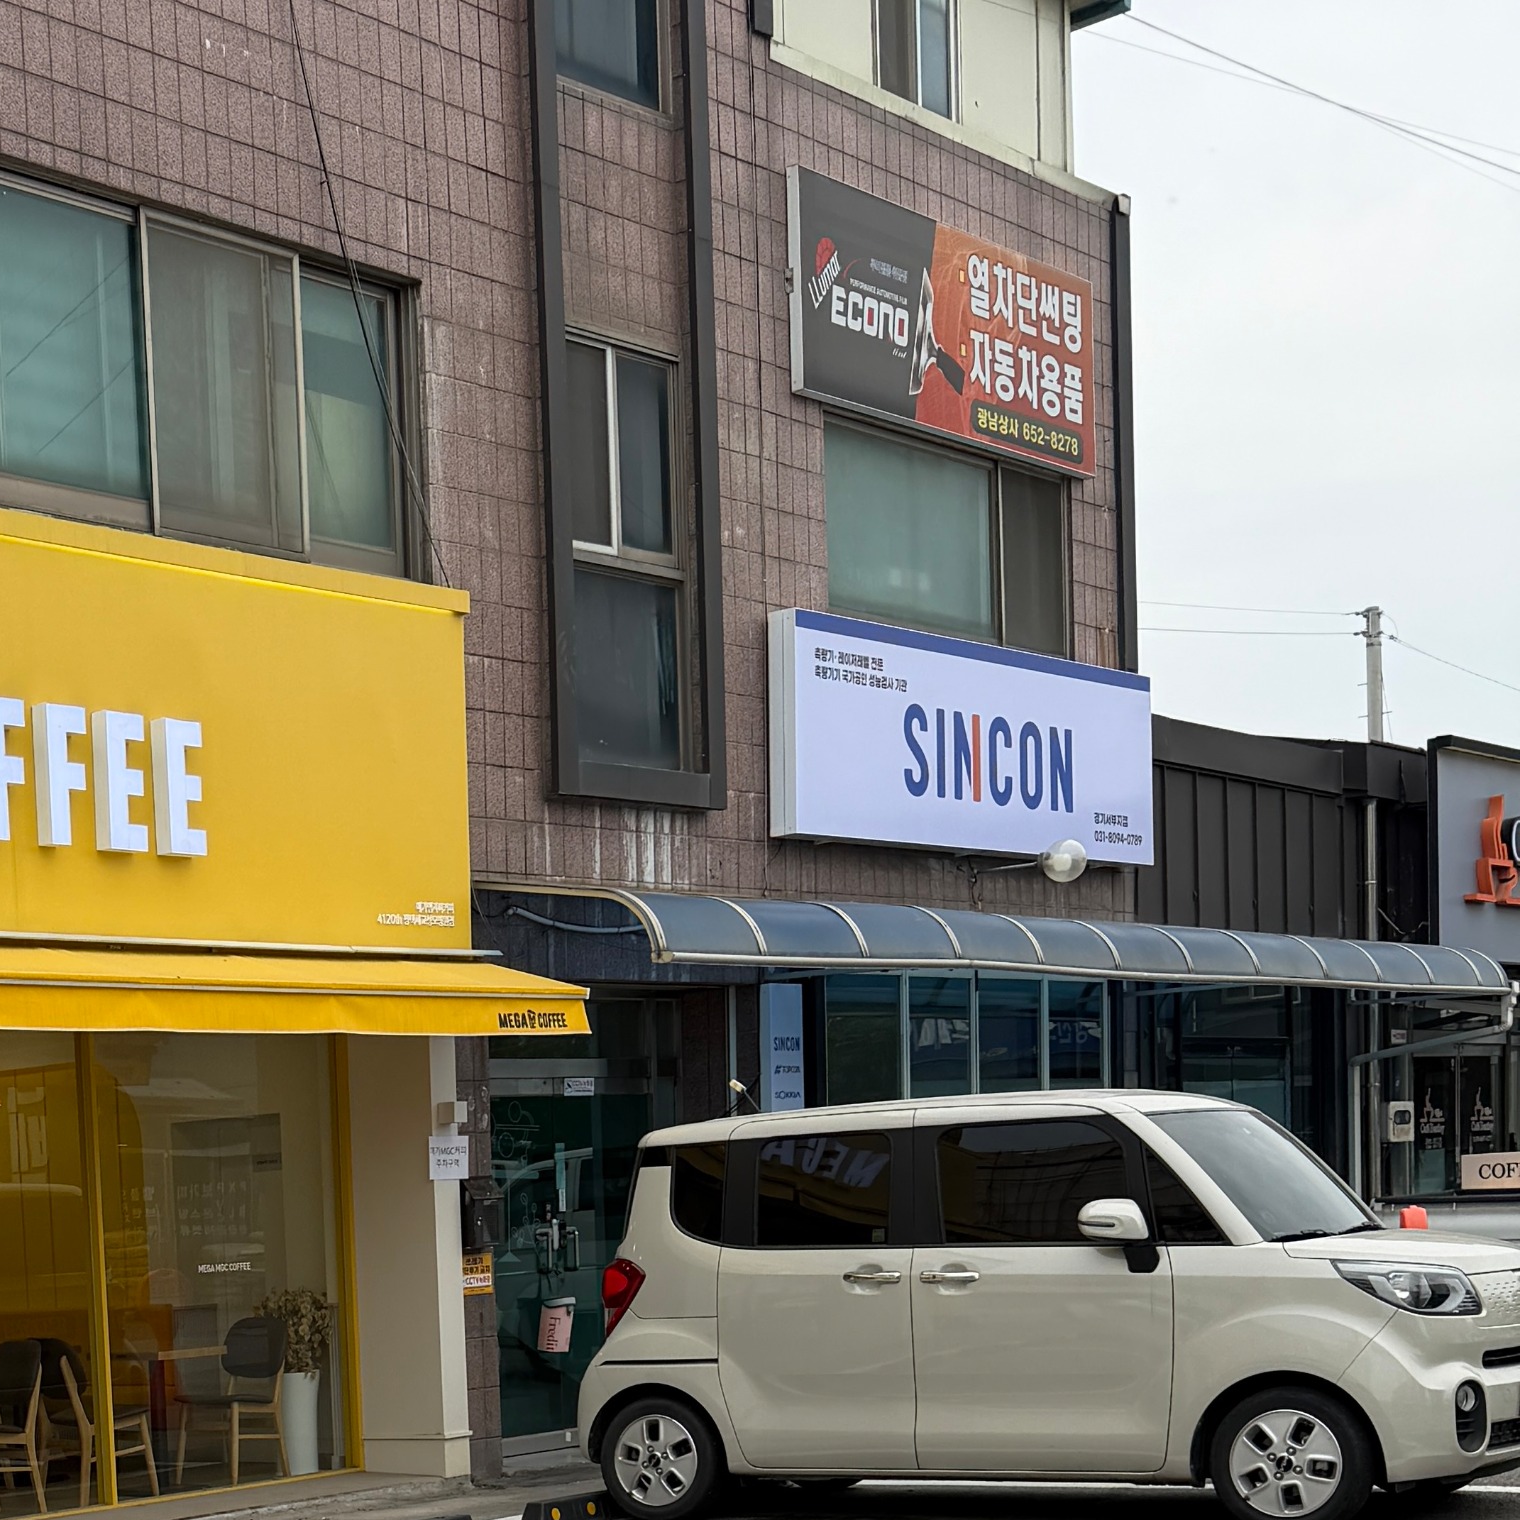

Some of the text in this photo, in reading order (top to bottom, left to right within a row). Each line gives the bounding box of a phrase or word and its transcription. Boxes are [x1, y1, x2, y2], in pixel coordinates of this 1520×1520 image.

[967, 254, 1083, 354] 열차단썬팅
[969, 329, 1084, 425] 자동차용품
[977, 407, 1080, 457] 광남상사 652-8278
[904, 703, 1074, 814] SINCON
[1094, 830, 1143, 846] 031-8094-0789
[498, 1012, 528, 1029] MEGA
[537, 1013, 568, 1029] COFFEE
[773, 1036, 801, 1052] SINCON
[229, 1262, 251, 1271] COFFEE
